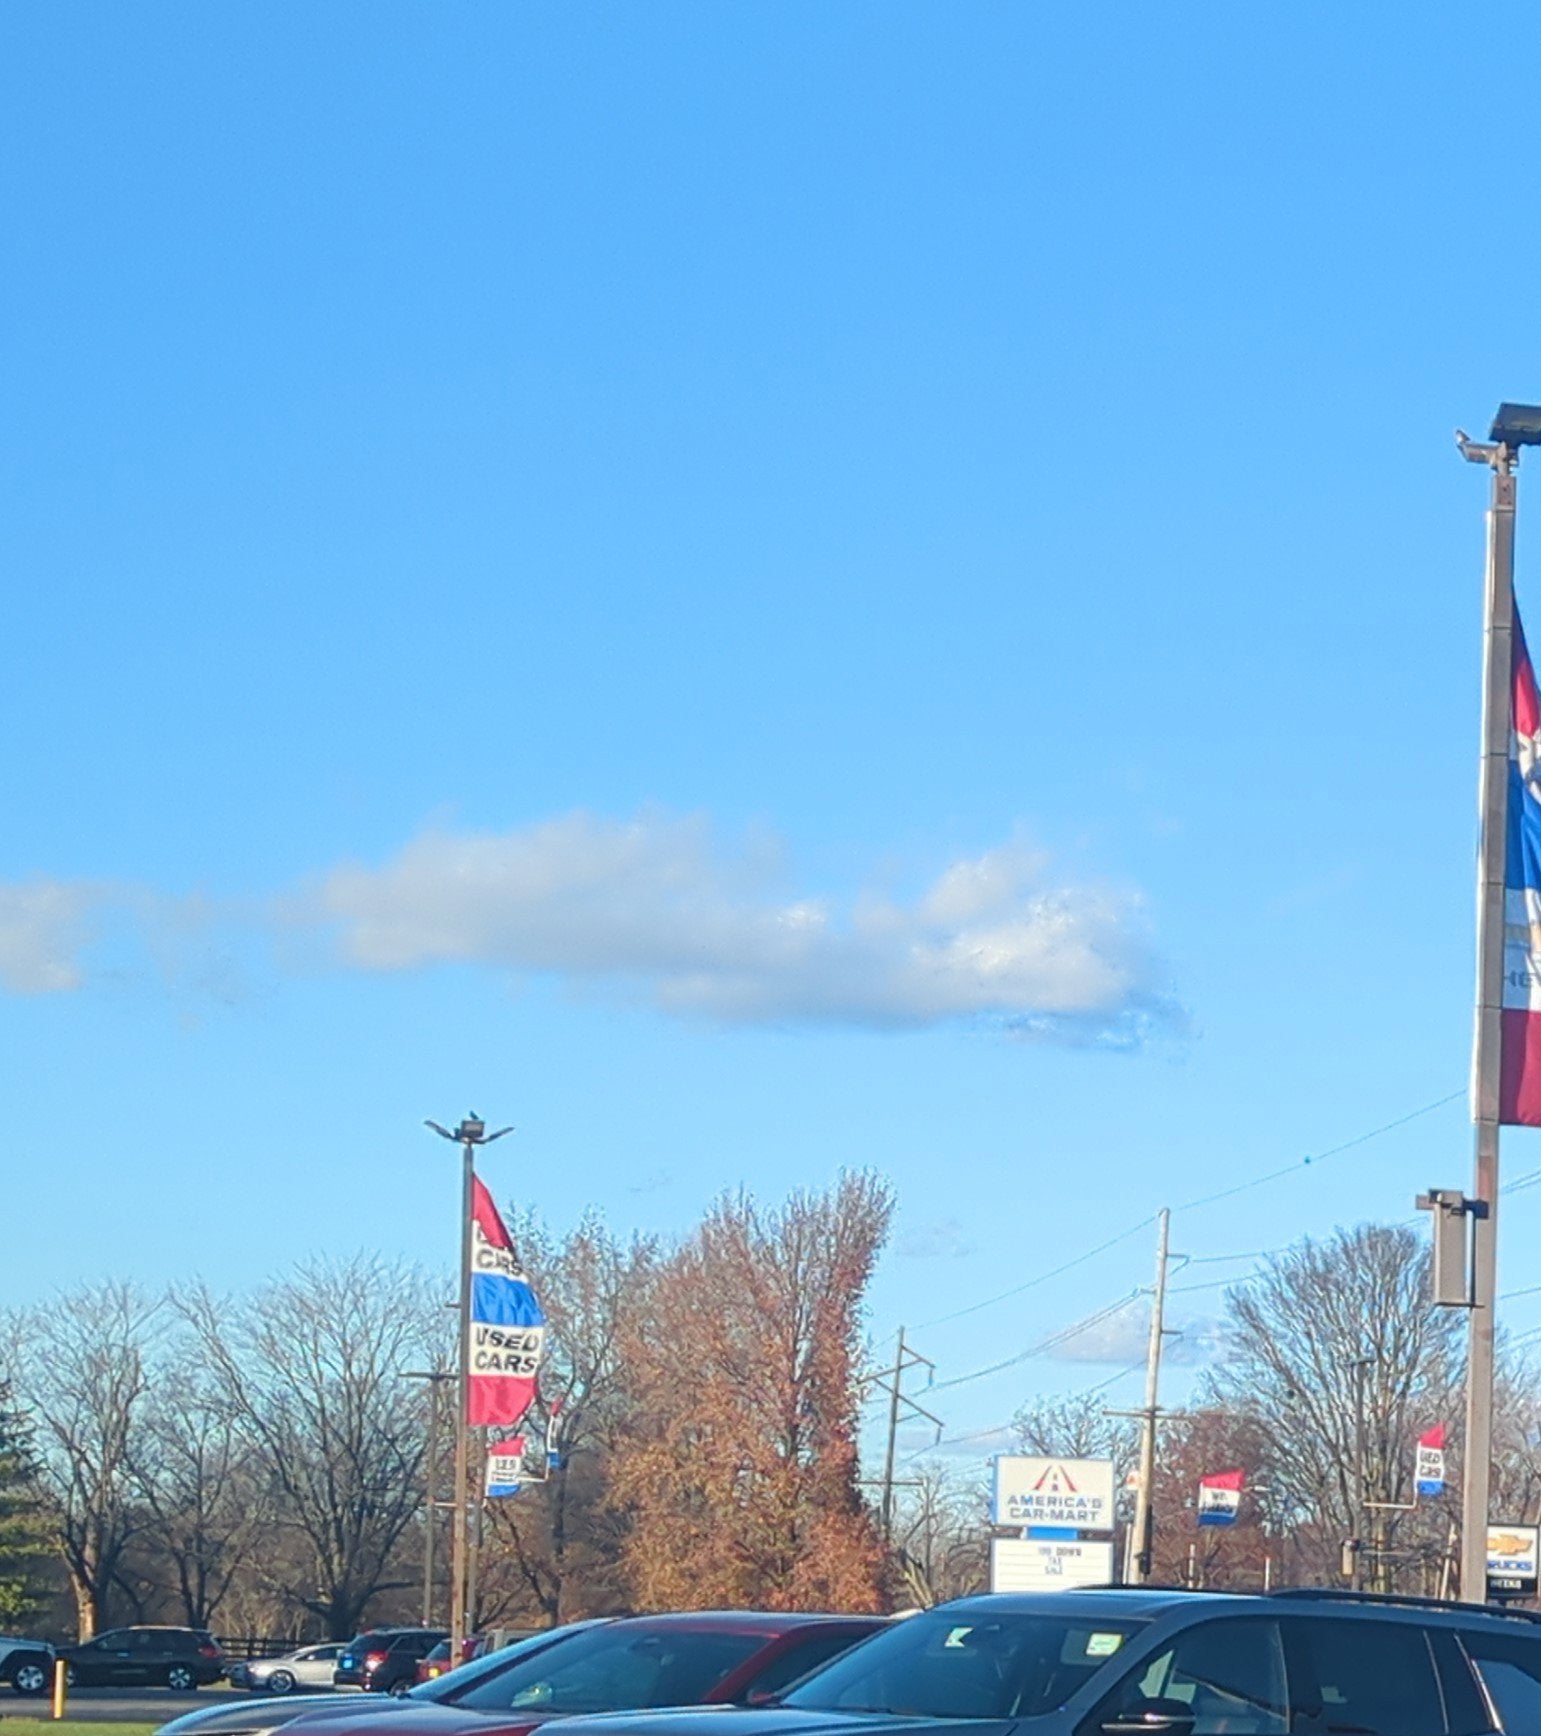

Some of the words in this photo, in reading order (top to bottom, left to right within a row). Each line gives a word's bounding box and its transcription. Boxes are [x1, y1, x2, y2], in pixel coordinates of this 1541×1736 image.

[476, 1327, 540, 1353] USED
[475, 1350, 538, 1374] CARS
[1007, 1495, 1103, 1509] AMERICA'S
